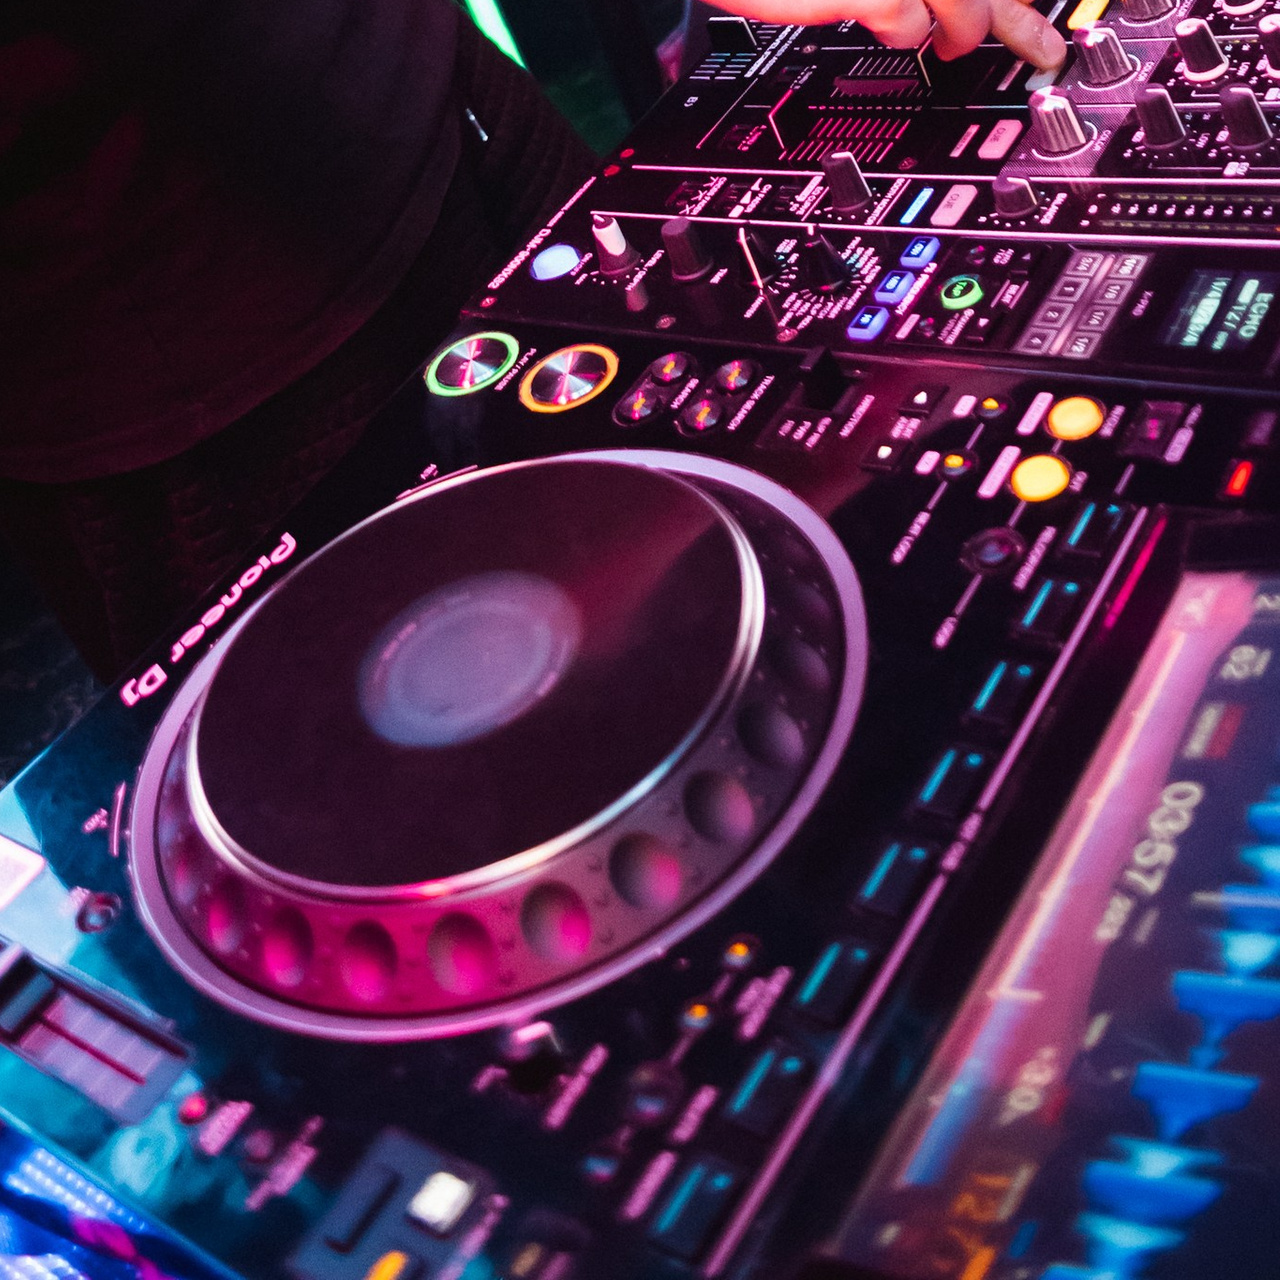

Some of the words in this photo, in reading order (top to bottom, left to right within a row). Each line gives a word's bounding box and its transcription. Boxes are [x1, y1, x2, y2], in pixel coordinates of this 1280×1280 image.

[710, 269, 727, 283] TIME
[953, 280, 966, 296] TAP
[1089, 312, 1104, 324] 1/4
[1240, 294, 1272, 337] ECHO
[1072, 338, 1088, 352] 1/2
[672, 379, 698, 408] SEARCH
[728, 400, 754, 430] SEARCH
[173, 535, 294, 660] Pioneer
[122, 665, 166, 704] DJ
